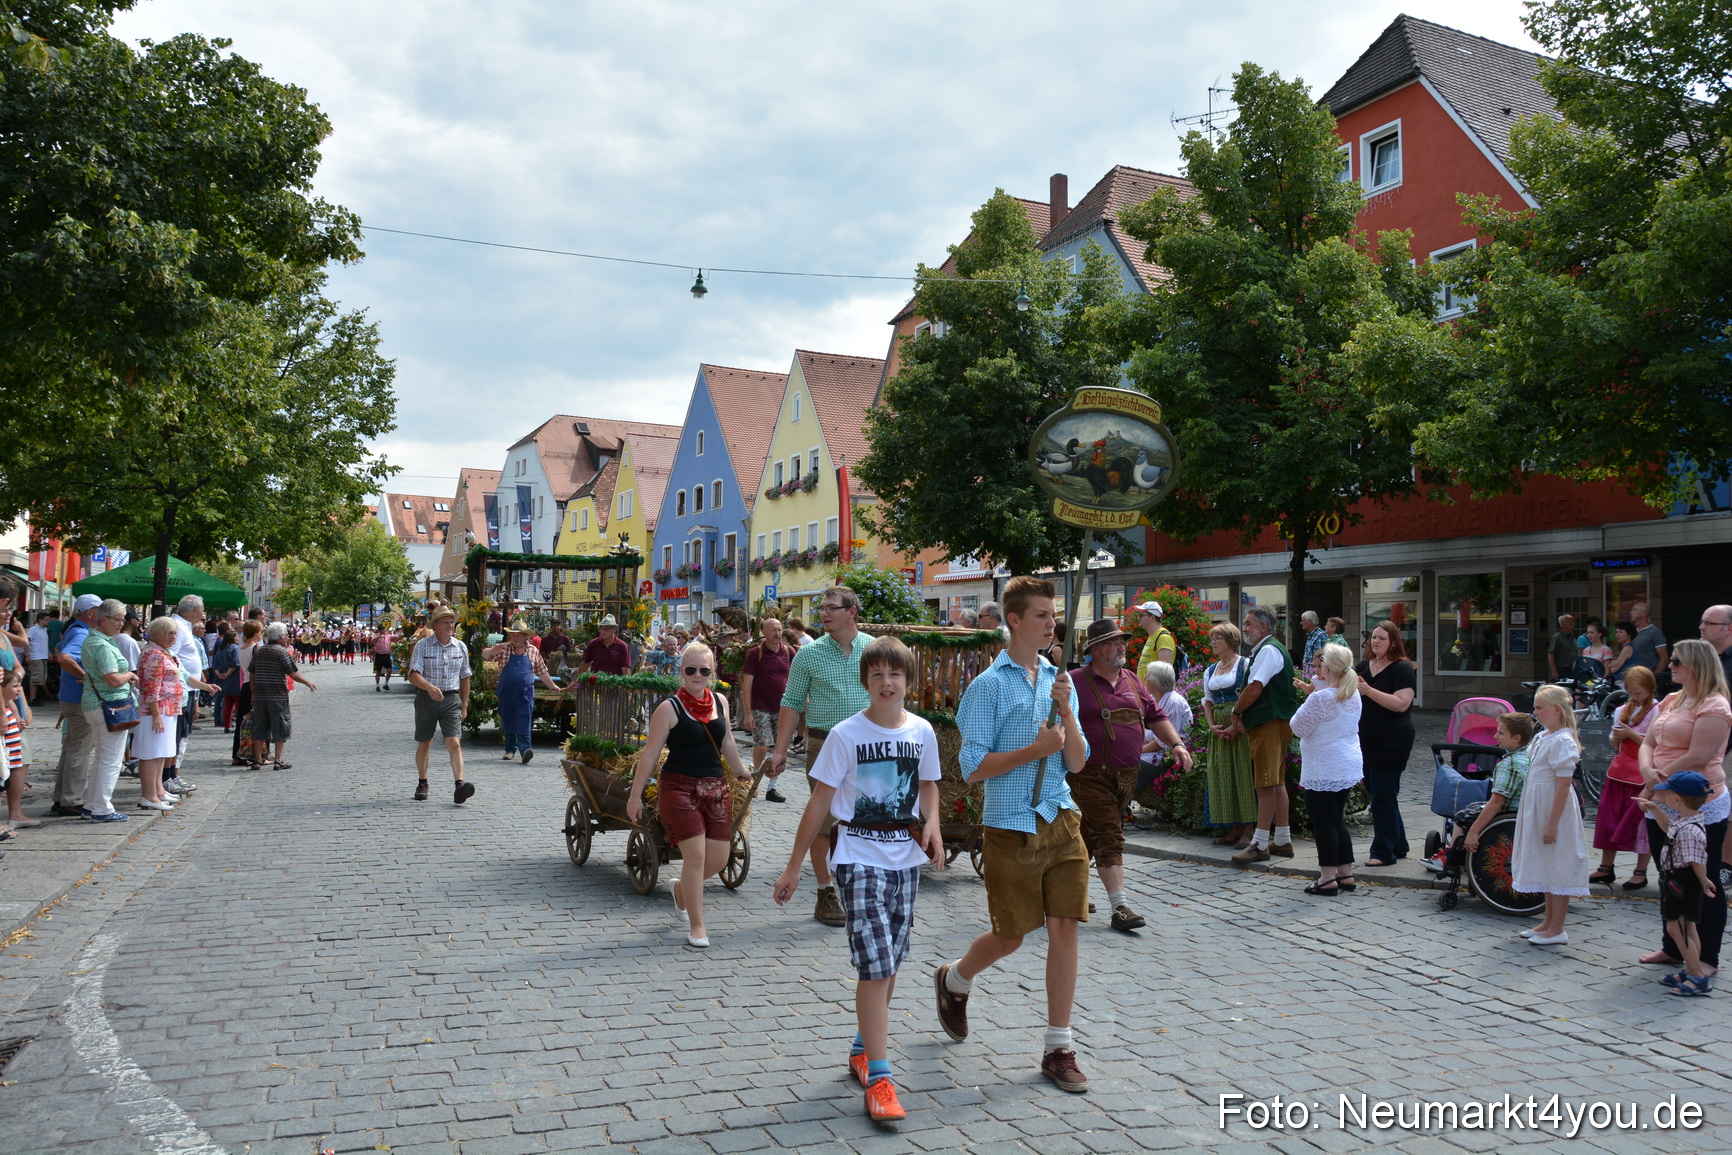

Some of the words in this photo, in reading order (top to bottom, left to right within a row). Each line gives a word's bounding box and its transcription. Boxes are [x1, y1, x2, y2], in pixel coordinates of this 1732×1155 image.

[1373, 510, 1441, 539] JOSEF
[1452, 495, 1589, 533] ZEININGER
[767, 587, 775, 599] P
[856, 741, 891, 760] MAKE
